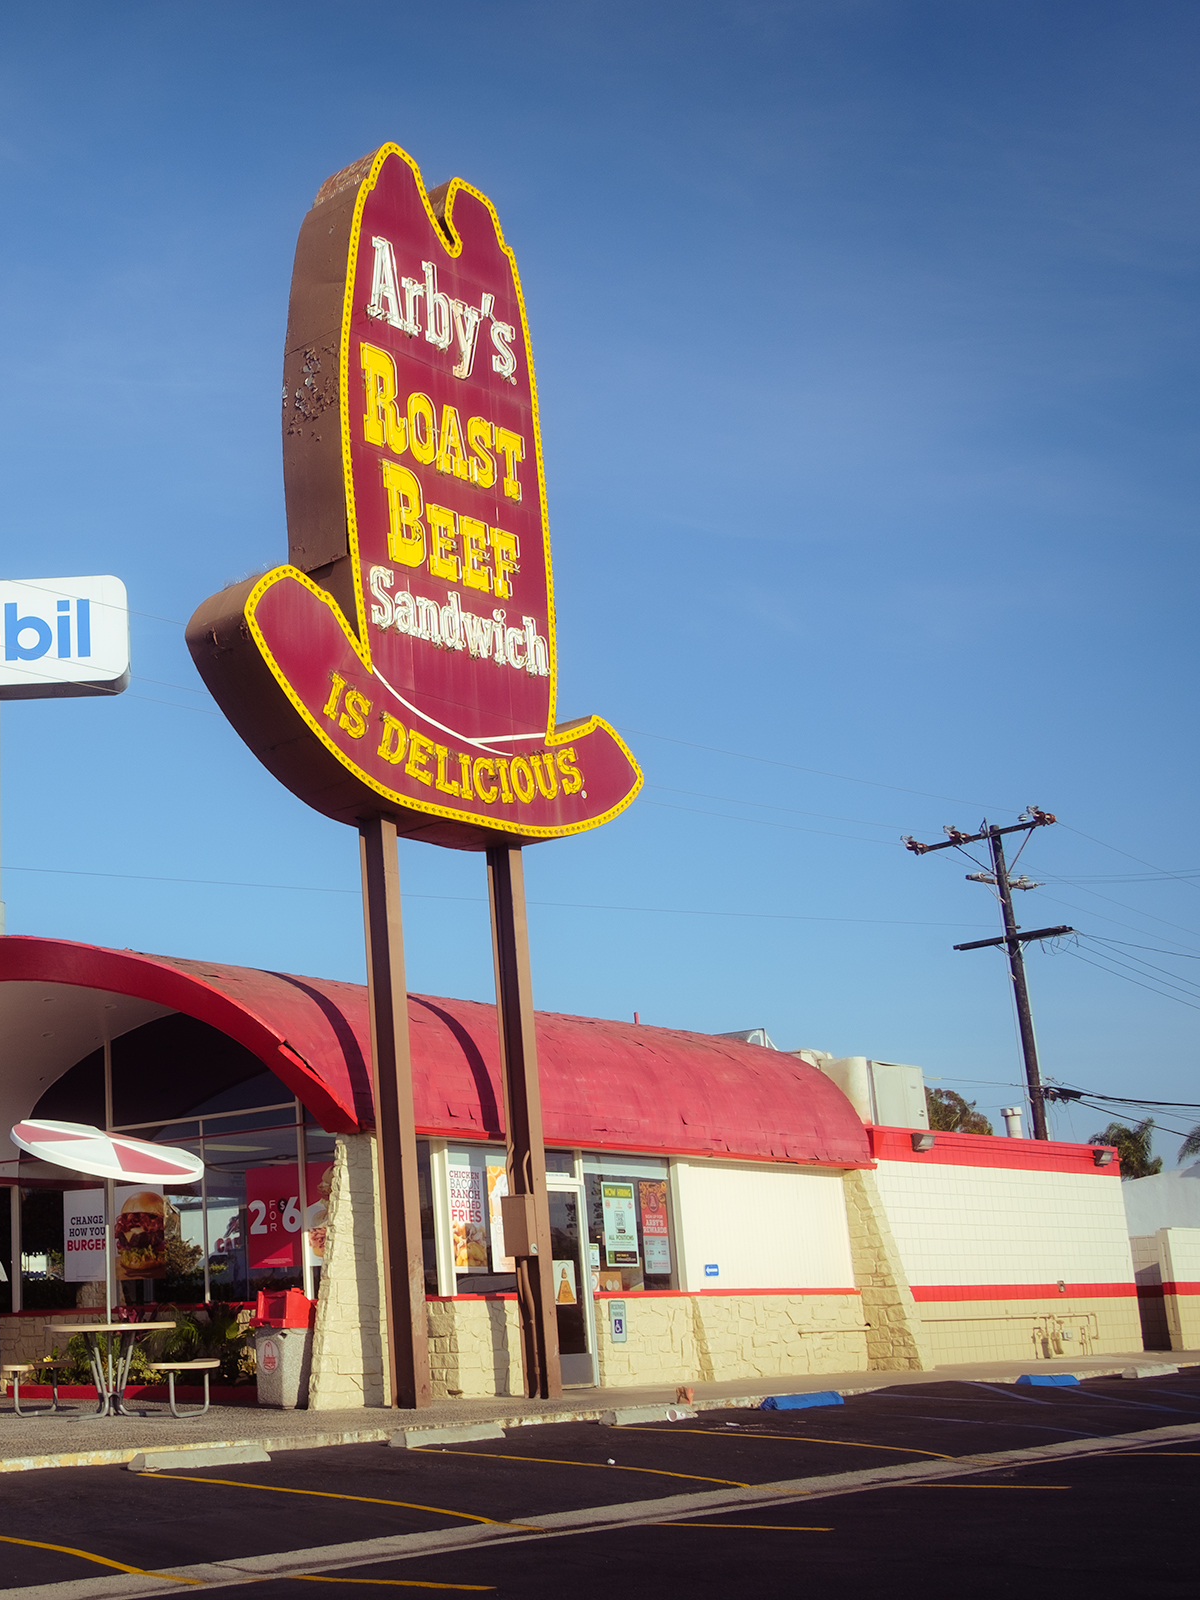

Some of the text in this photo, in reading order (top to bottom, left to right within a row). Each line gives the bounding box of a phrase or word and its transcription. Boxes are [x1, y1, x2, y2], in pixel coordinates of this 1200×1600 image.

[367, 236, 517, 379] Arby's
[360, 342, 526, 501] ROAST
[382, 459, 520, 599] BEEF
[369, 565, 550, 677] Sandwich
[323, 673, 372, 739] IS
[449, 1170, 479, 1179] CHICKEN
[450, 1179, 480, 1190] BACON
[450, 1189, 481, 1200] RANCH
[451, 1200, 482, 1210] LOADED
[70, 1215, 104, 1226] CHANGE
[248, 1200, 268, 1235] 2
[269, 1200, 277, 1232] FOR
[451, 1209, 482, 1223] FRIES
[69, 1228, 88, 1237] HOW
